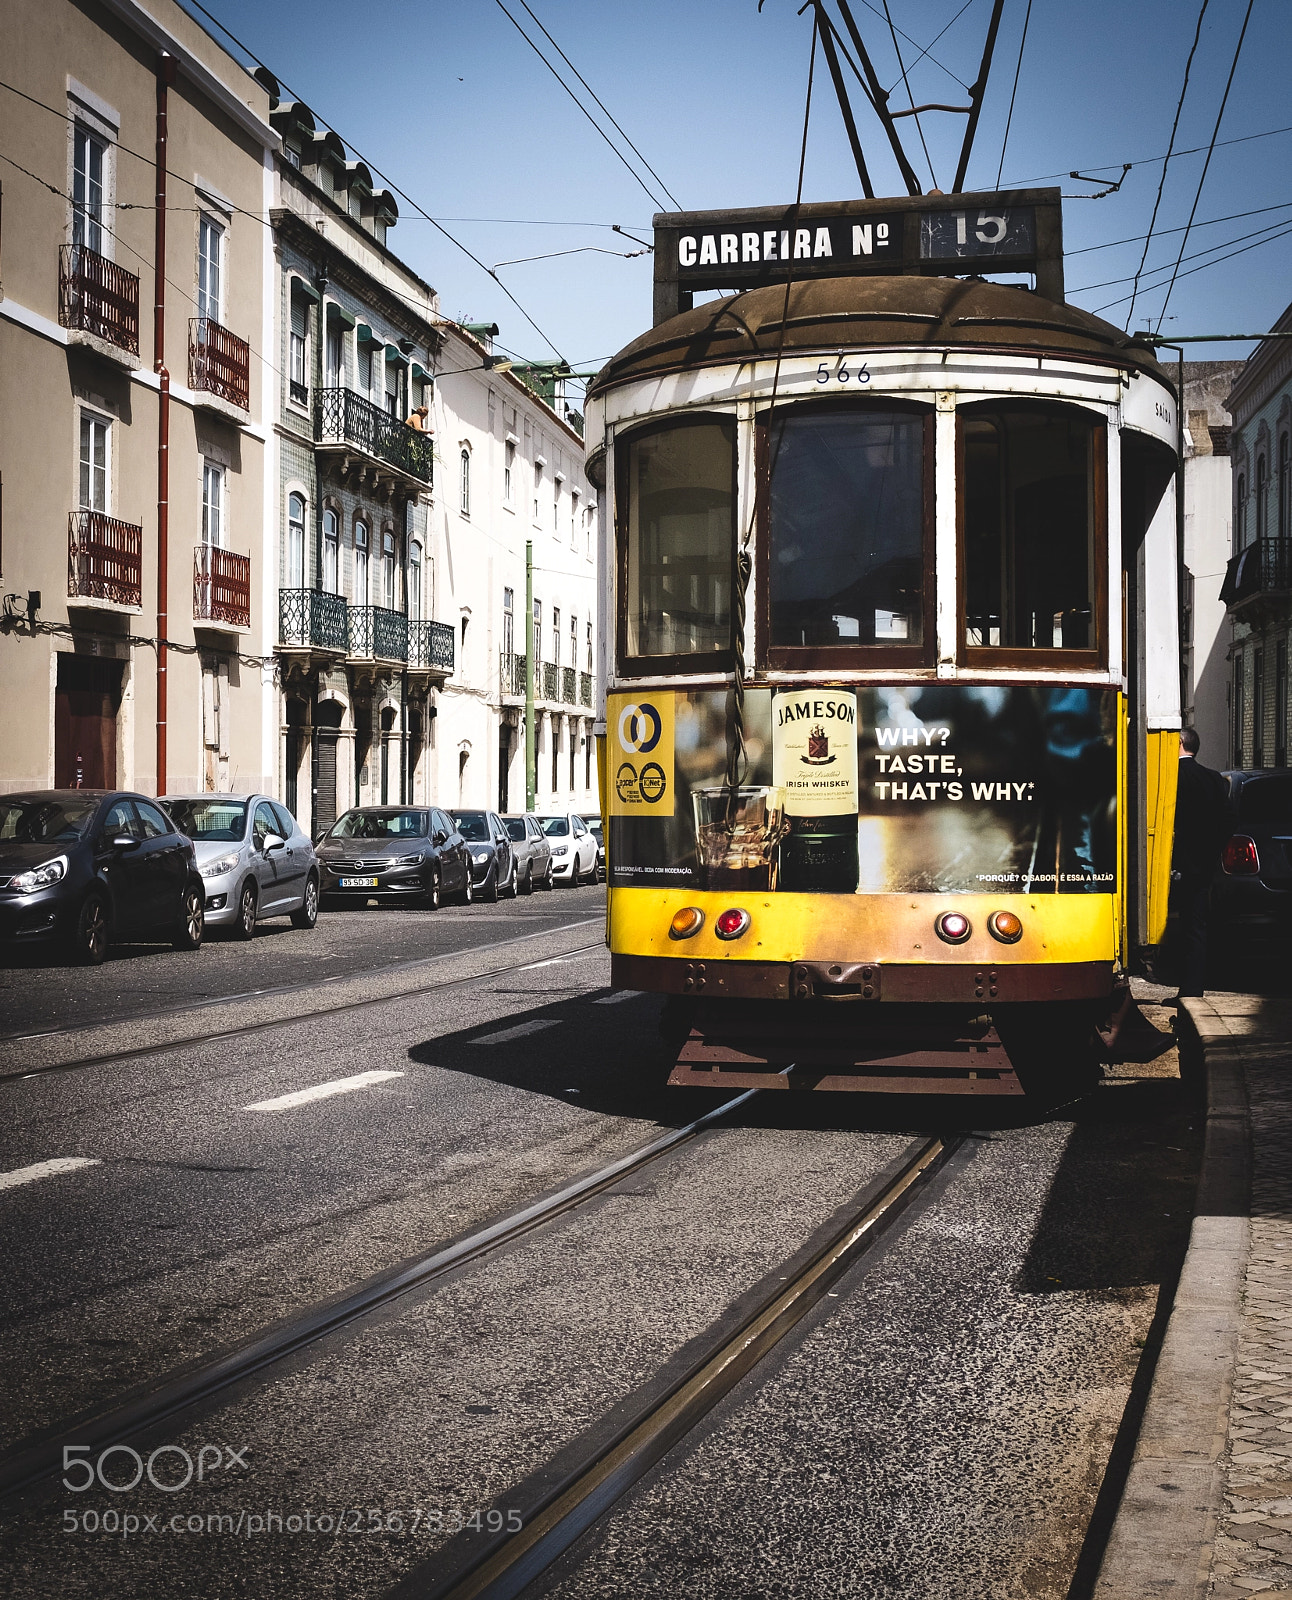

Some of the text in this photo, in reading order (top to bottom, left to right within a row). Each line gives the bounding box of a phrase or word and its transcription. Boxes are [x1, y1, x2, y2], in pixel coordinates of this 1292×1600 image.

[678, 227, 832, 267] CARREIRA
[951, 209, 1007, 244] 15
[816, 362, 871, 384] 566
[778, 701, 855, 727] JAMESON
[875, 727, 951, 746] WHY?
[875, 755, 963, 776] TASTE,
[875, 782, 963, 800] THAT'S
[1021, 874, 1027, 882] O
[1060, 873, 1065, 881] É
[1092, 872, 1114, 881] RAZÃO
